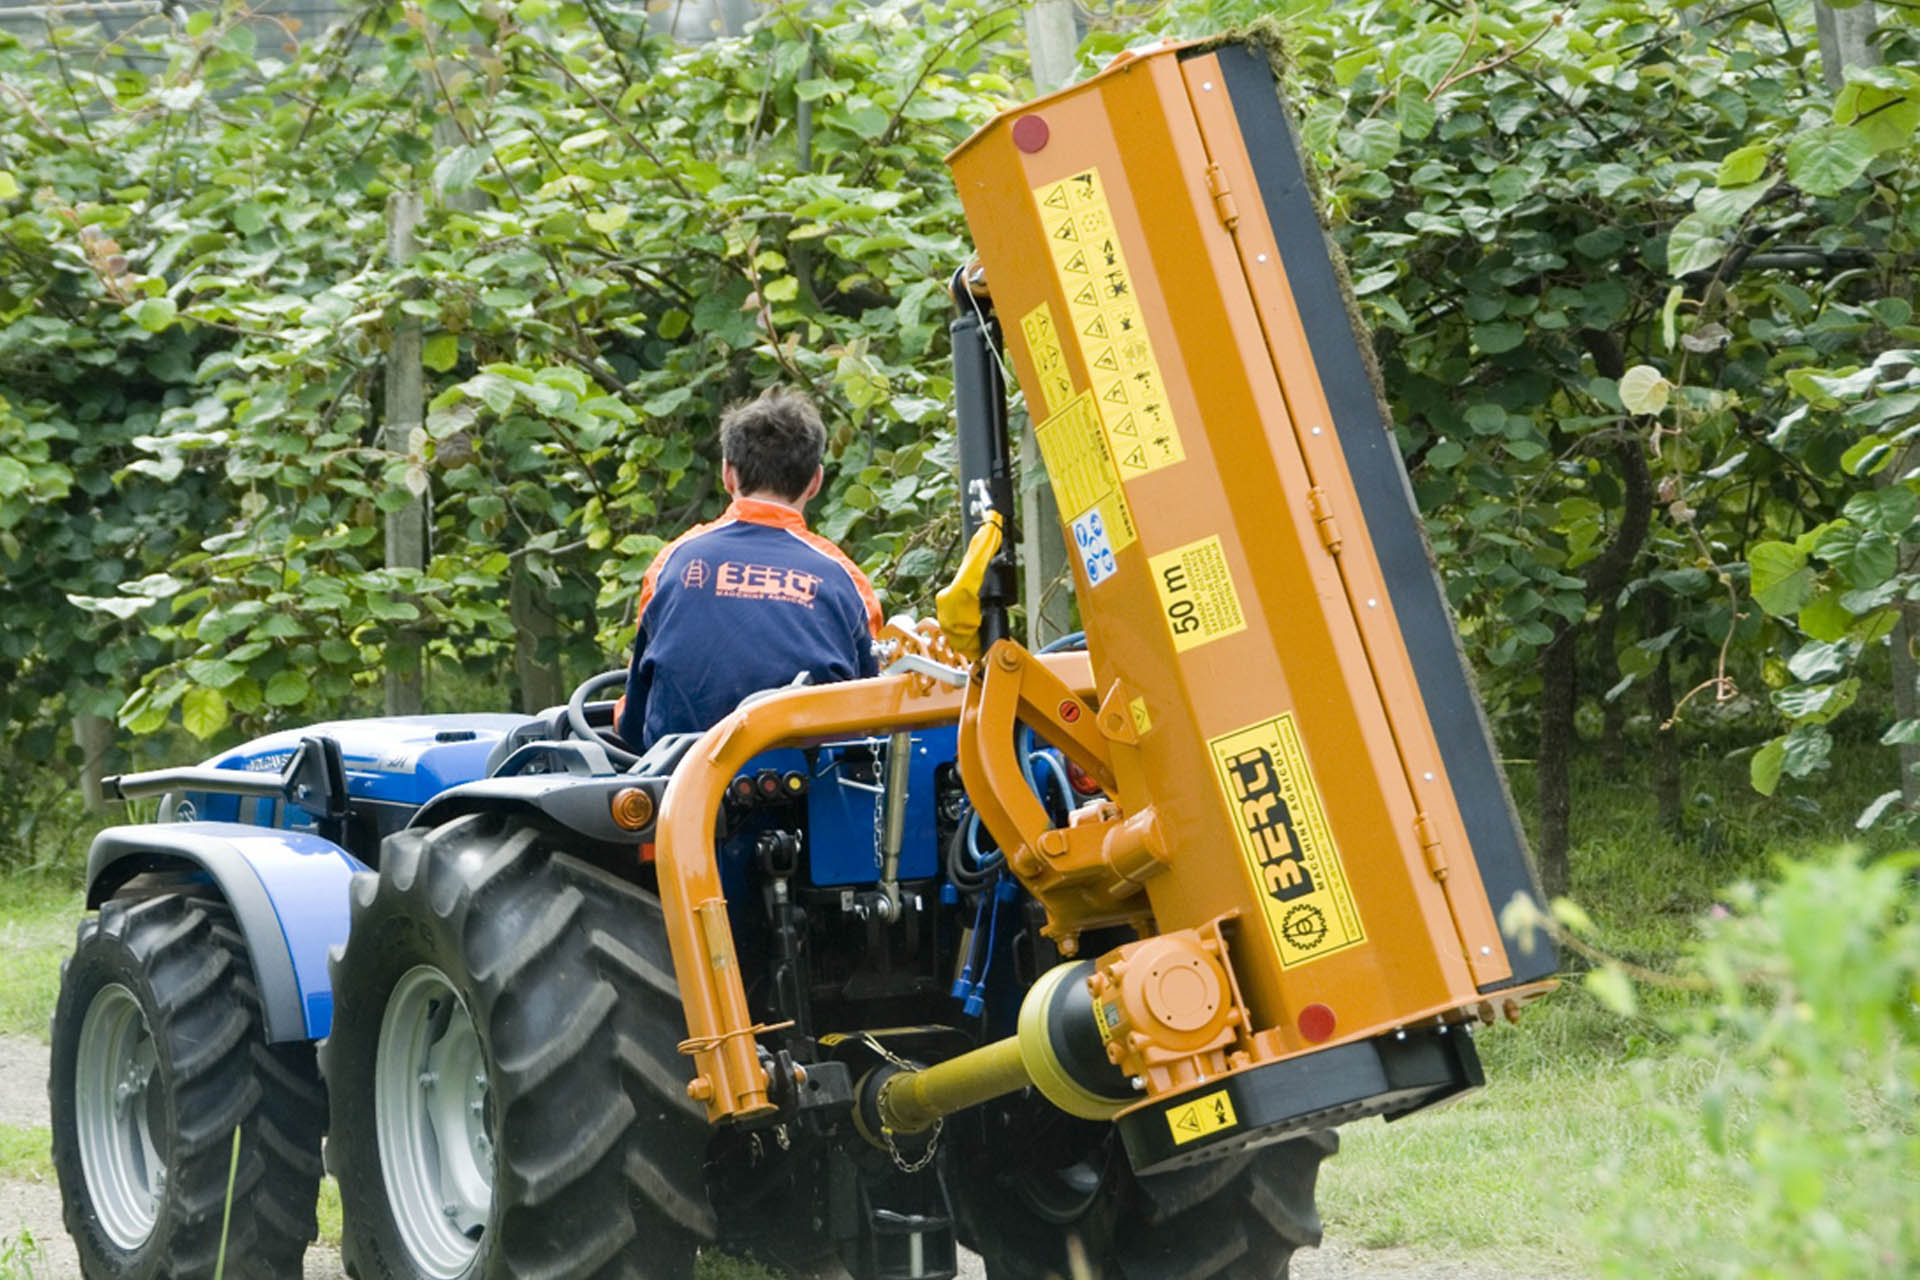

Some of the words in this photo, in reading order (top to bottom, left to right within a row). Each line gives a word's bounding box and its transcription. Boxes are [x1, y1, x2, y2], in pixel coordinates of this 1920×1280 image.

[1163, 564, 1187, 593] m
[1168, 599, 1200, 635] 50
[1270, 741, 1299, 811] AGRICOLE
[1297, 819, 1325, 891] MACCHINE
